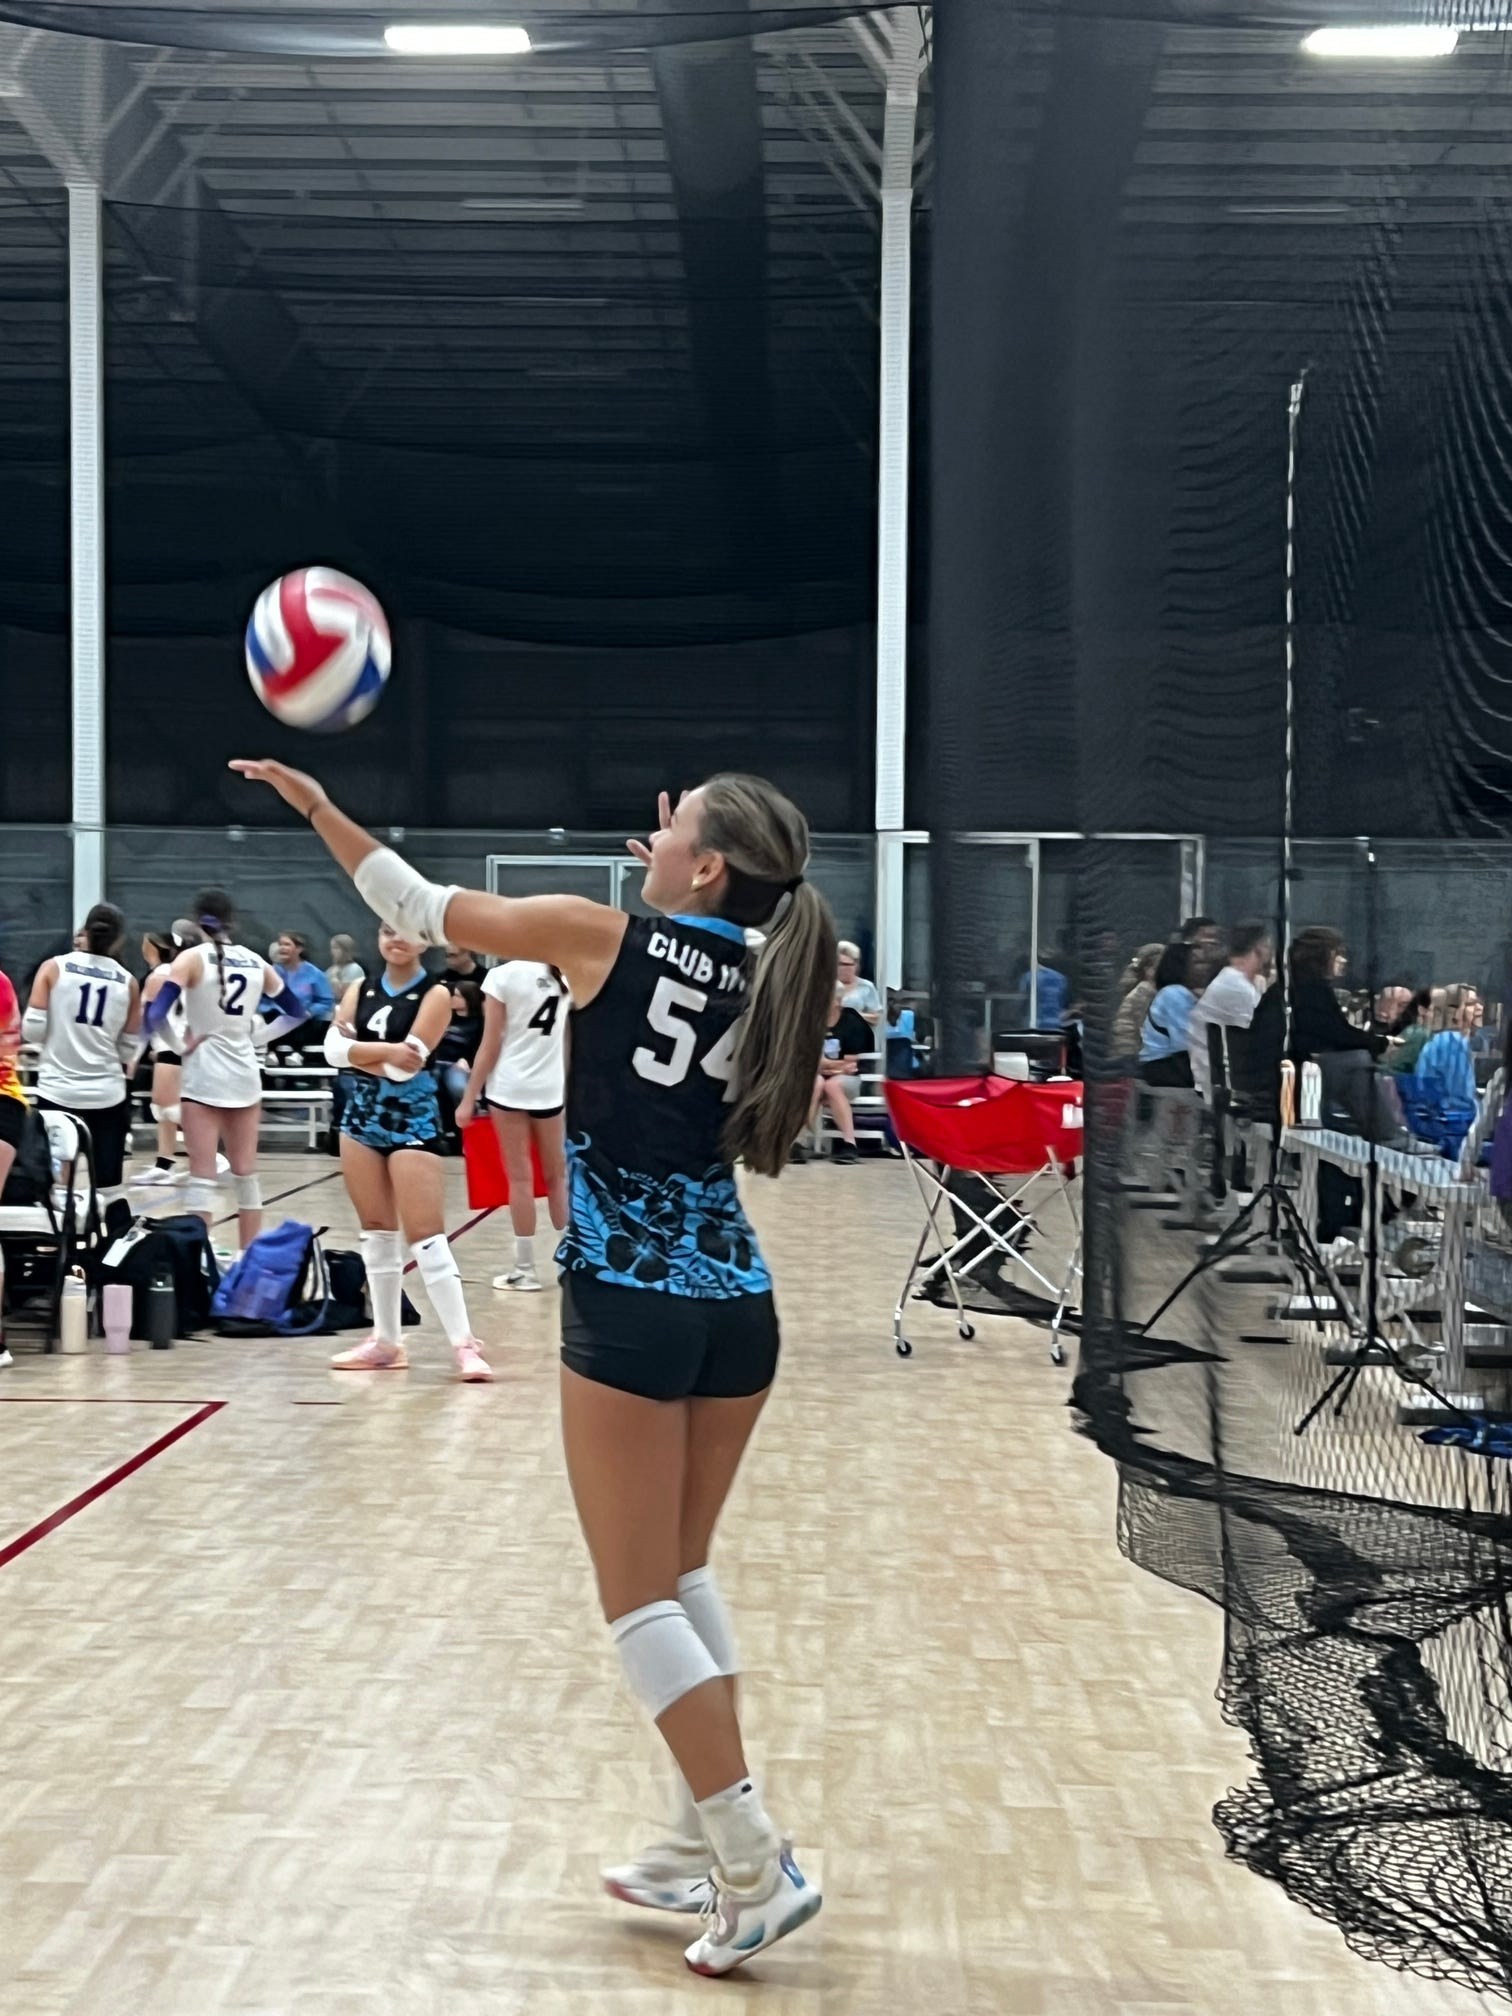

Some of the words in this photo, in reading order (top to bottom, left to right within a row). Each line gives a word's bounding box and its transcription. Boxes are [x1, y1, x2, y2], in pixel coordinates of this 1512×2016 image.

[647, 932, 714, 984] CLUB
[75, 982, 108, 1027] 11
[366, 1004, 393, 1040] 4
[527, 995, 560, 1036] 4
